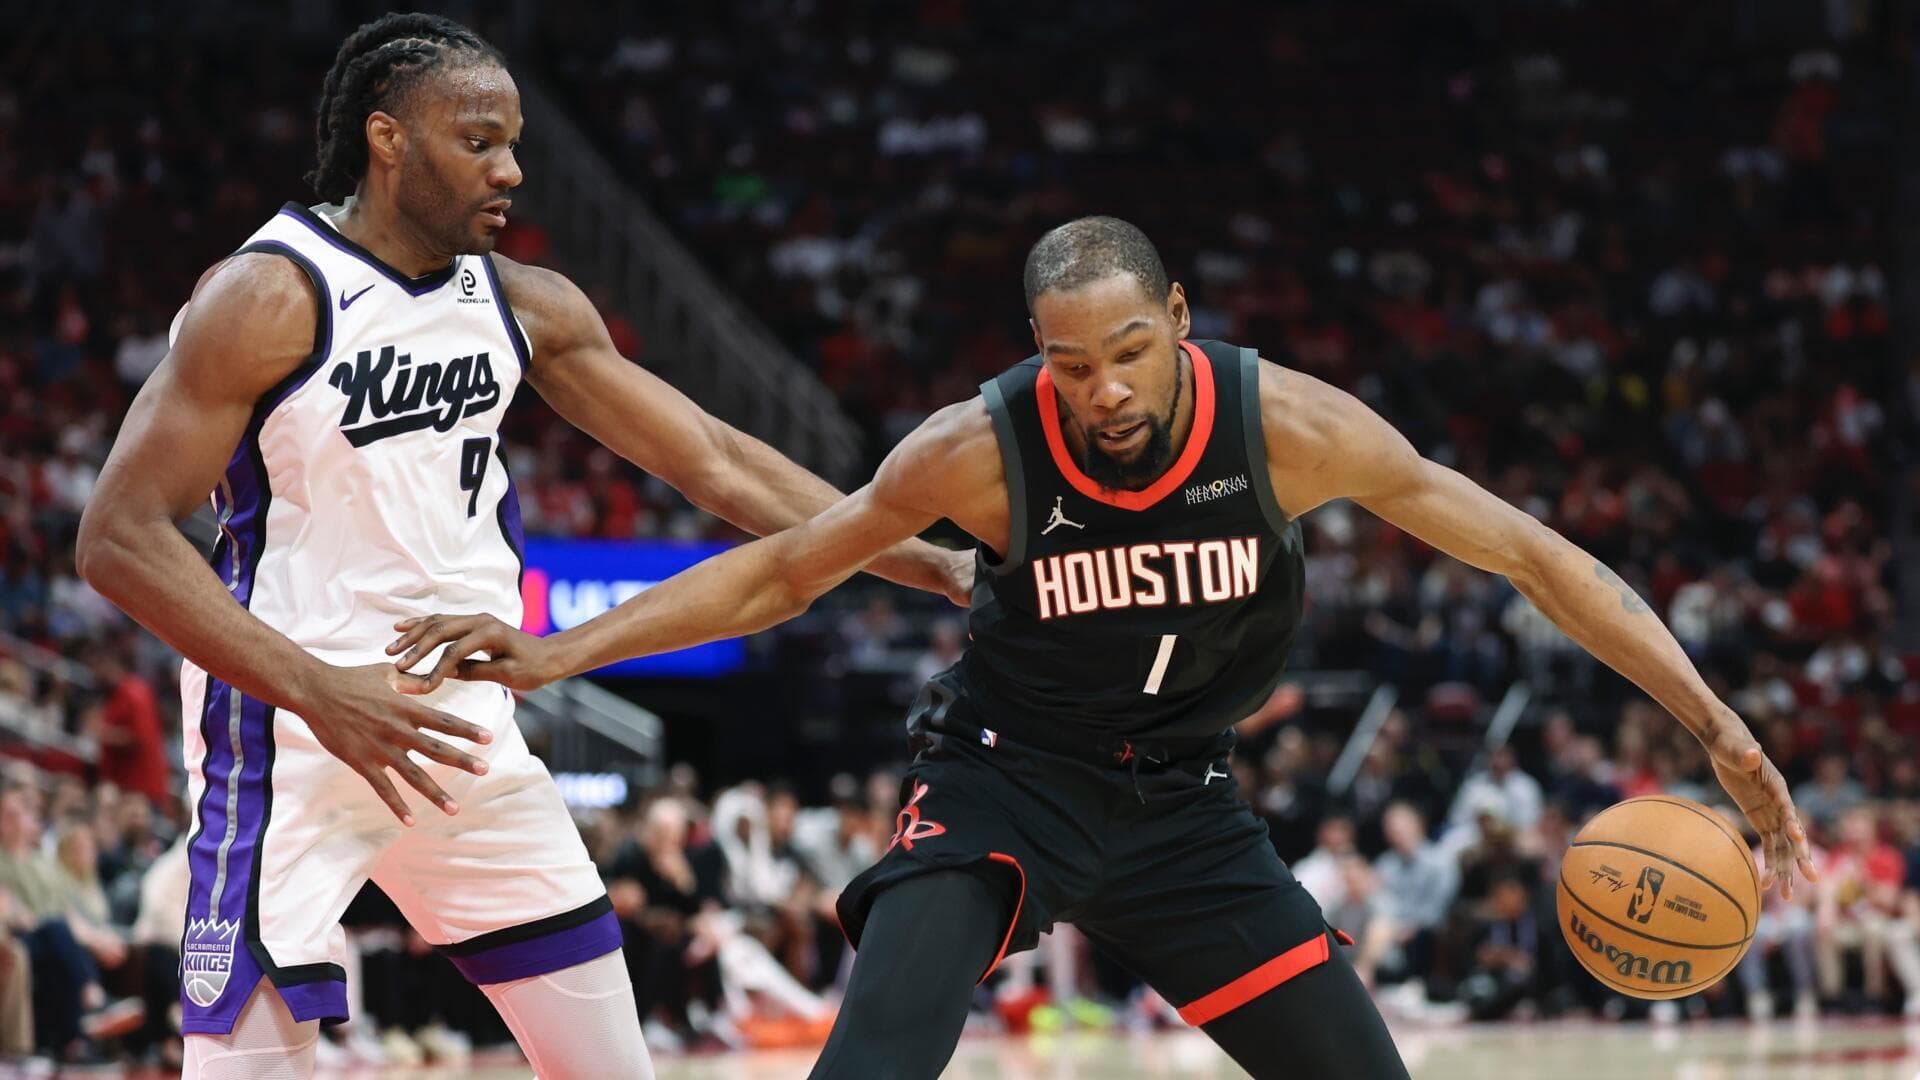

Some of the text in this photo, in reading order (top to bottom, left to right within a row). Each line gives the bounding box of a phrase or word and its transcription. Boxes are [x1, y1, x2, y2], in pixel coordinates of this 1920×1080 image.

[328, 345, 500, 448] Kings
[460, 436, 491, 519] 9
[1185, 473, 1248, 498] MEMORIAL
[1187, 479, 1248, 505] HERMANN
[1032, 536, 1260, 620] HOUSTON
[1143, 634, 1178, 695] 1
[185, 954, 231, 973] KINGS
[186, 943, 231, 952] SACRAMENTO
[1571, 910, 1692, 984] Wilson
